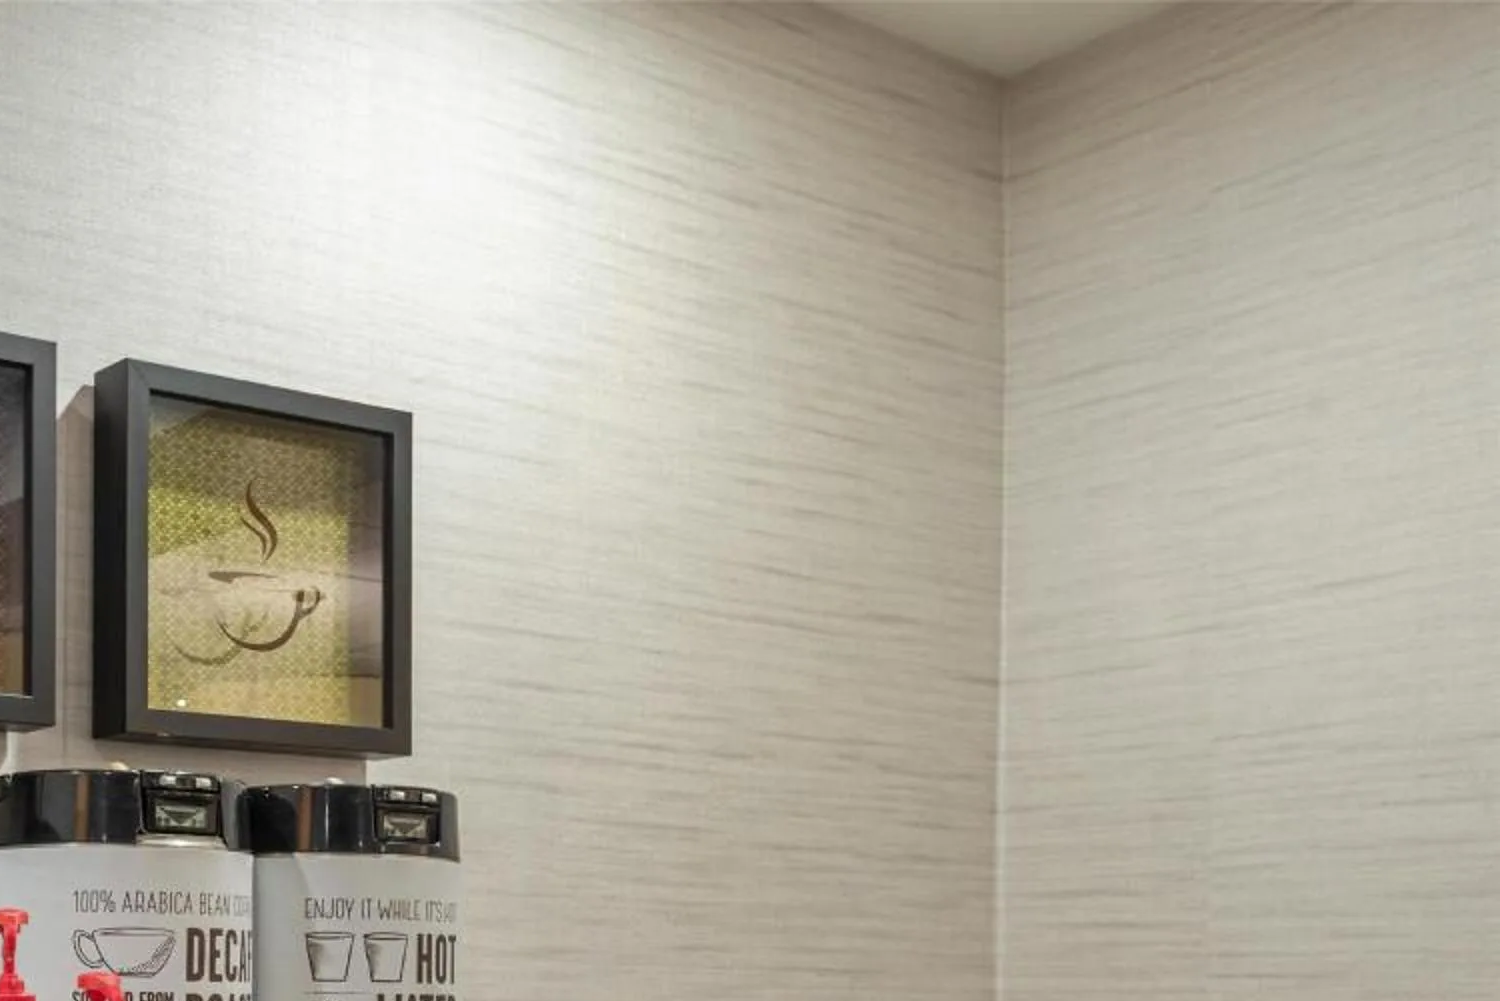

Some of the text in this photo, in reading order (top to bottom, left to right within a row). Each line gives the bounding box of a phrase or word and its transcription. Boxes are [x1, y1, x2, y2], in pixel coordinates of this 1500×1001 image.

[74, 890, 116, 913] 100%
[121, 891, 193, 915] ARABICA
[199, 892, 230, 916] BEAN
[305, 898, 354, 920] ENJOY
[361, 898, 372, 920] IT
[377, 899, 420, 920] WHILE
[416, 933, 456, 984] HOT
